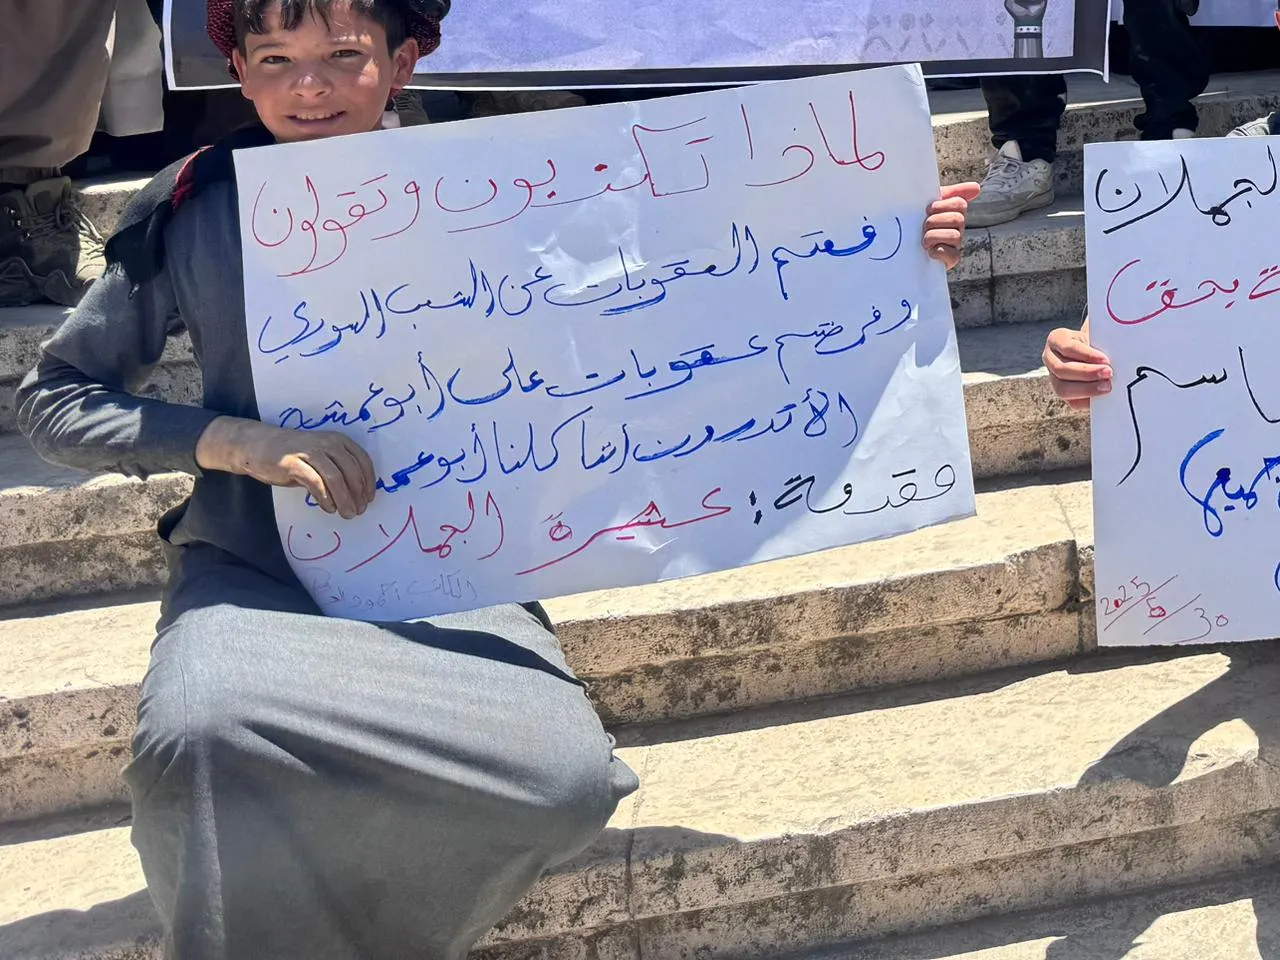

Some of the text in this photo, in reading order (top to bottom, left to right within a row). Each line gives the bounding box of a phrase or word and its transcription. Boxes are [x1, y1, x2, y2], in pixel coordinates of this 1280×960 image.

[743, 89, 886, 188] لماذا
[498, 266, 553, 317] عن
[543, 221, 759, 317] العقوبات
[1106, 259, 1240, 326] بحق
[258, 287, 387, 365] السوري
[446, 347, 545, 406] على
[545, 334, 769, 401] عقوبات
[515, 487, 732, 576] عشيرة
